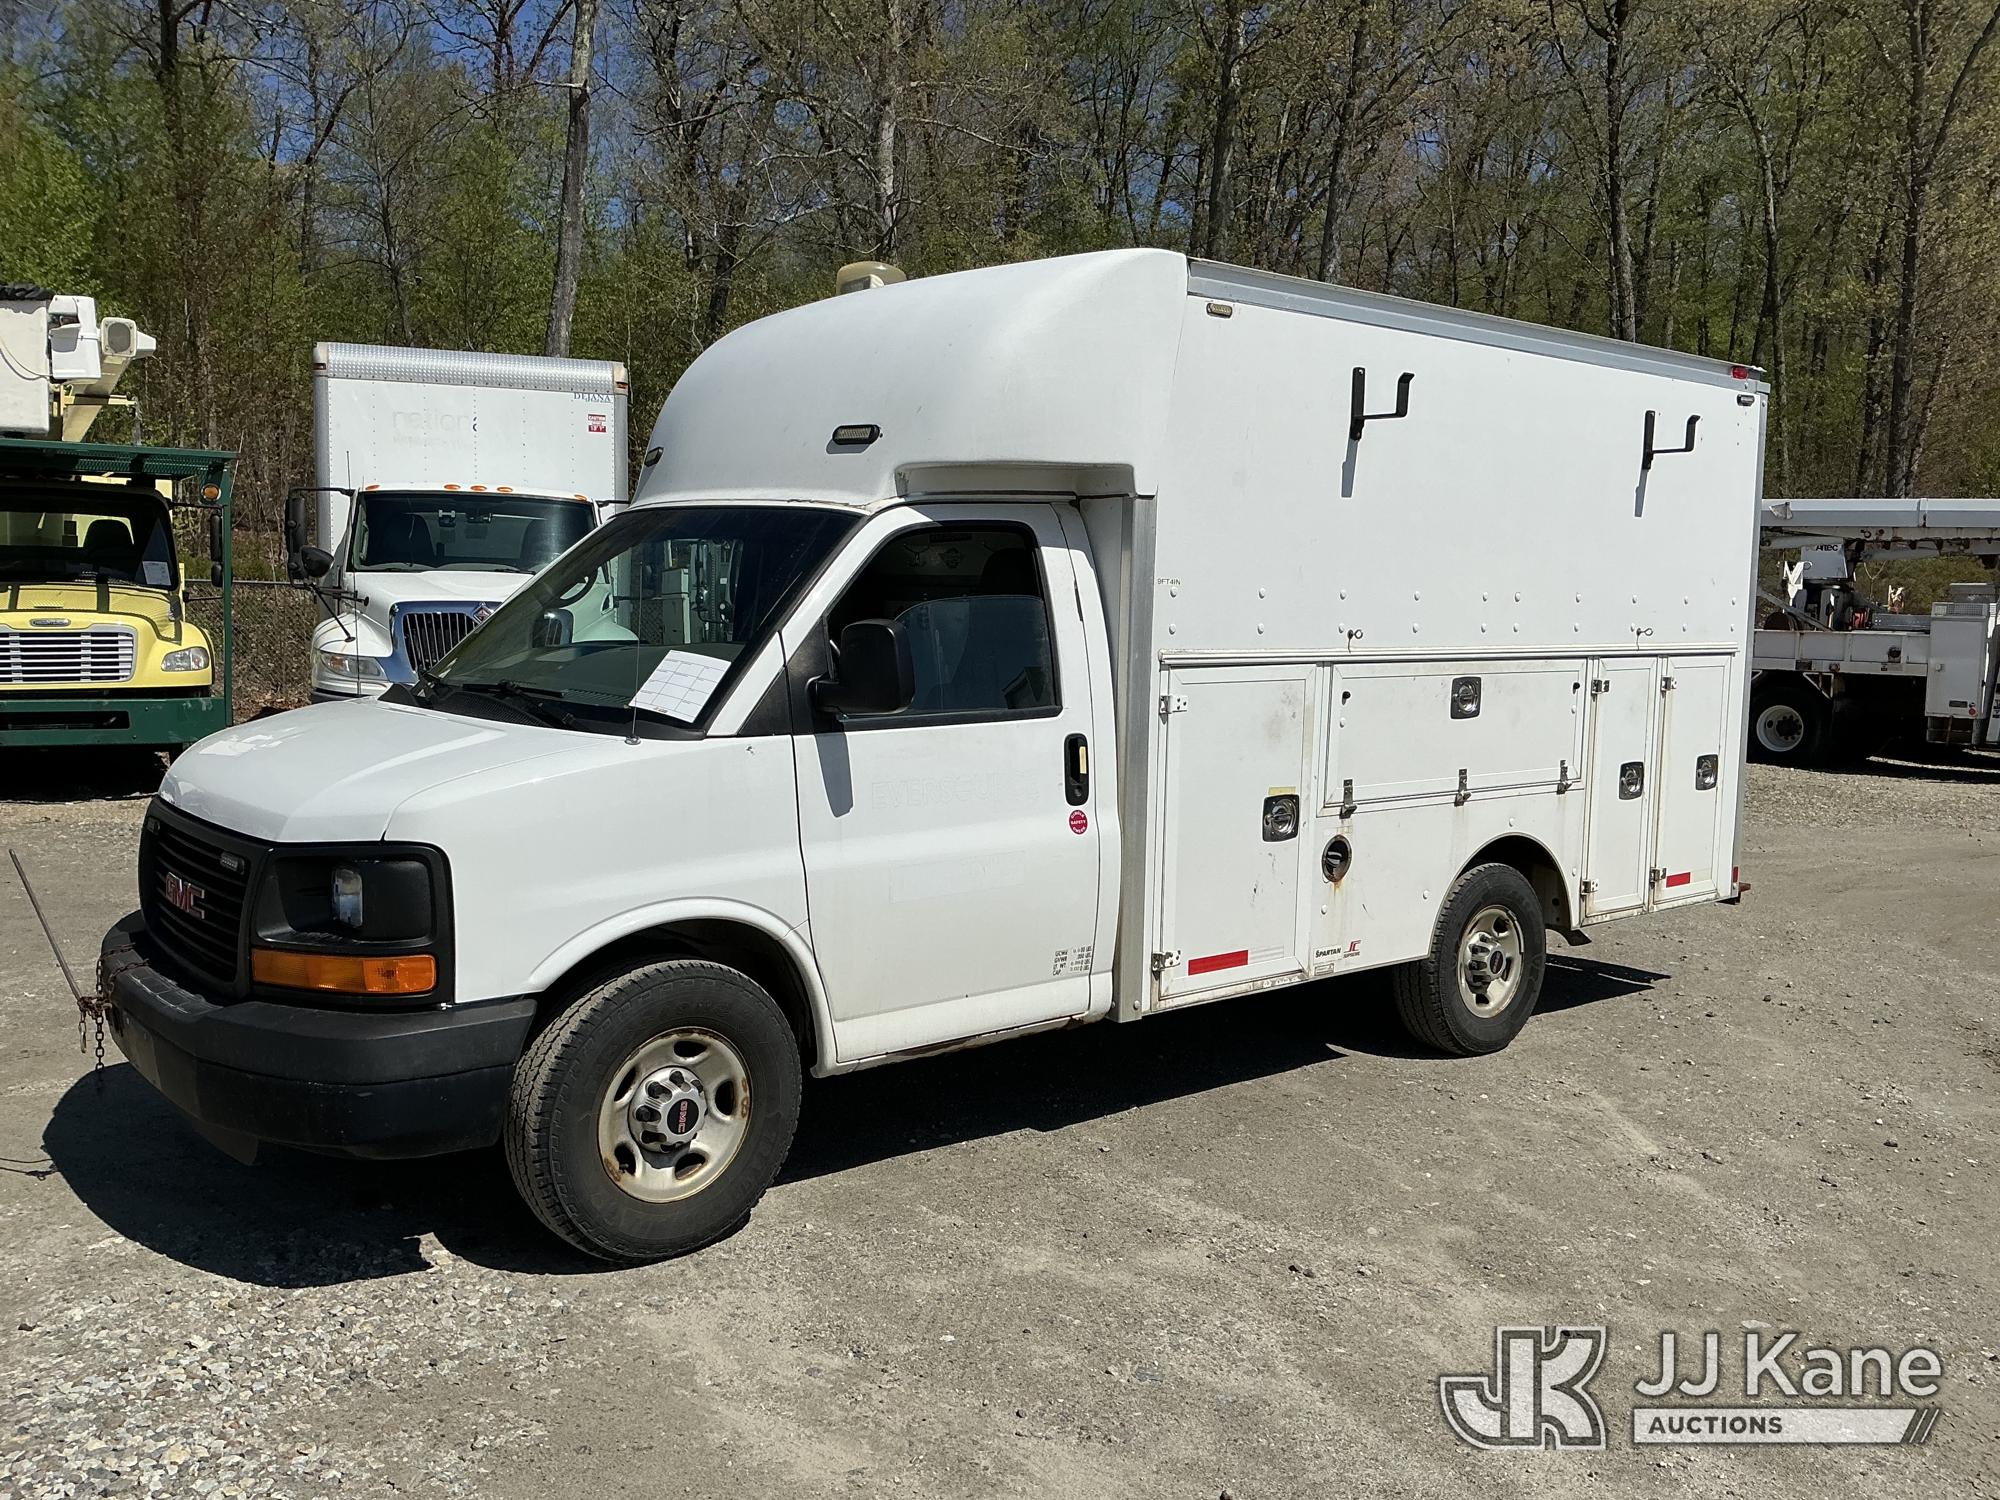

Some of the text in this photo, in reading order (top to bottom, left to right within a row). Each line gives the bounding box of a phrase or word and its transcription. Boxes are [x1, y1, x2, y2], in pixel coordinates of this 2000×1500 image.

[166, 872, 205, 919] GMC
[1315, 948, 1341, 958] SPARTAN
[677, 1100, 689, 1134] GMC
